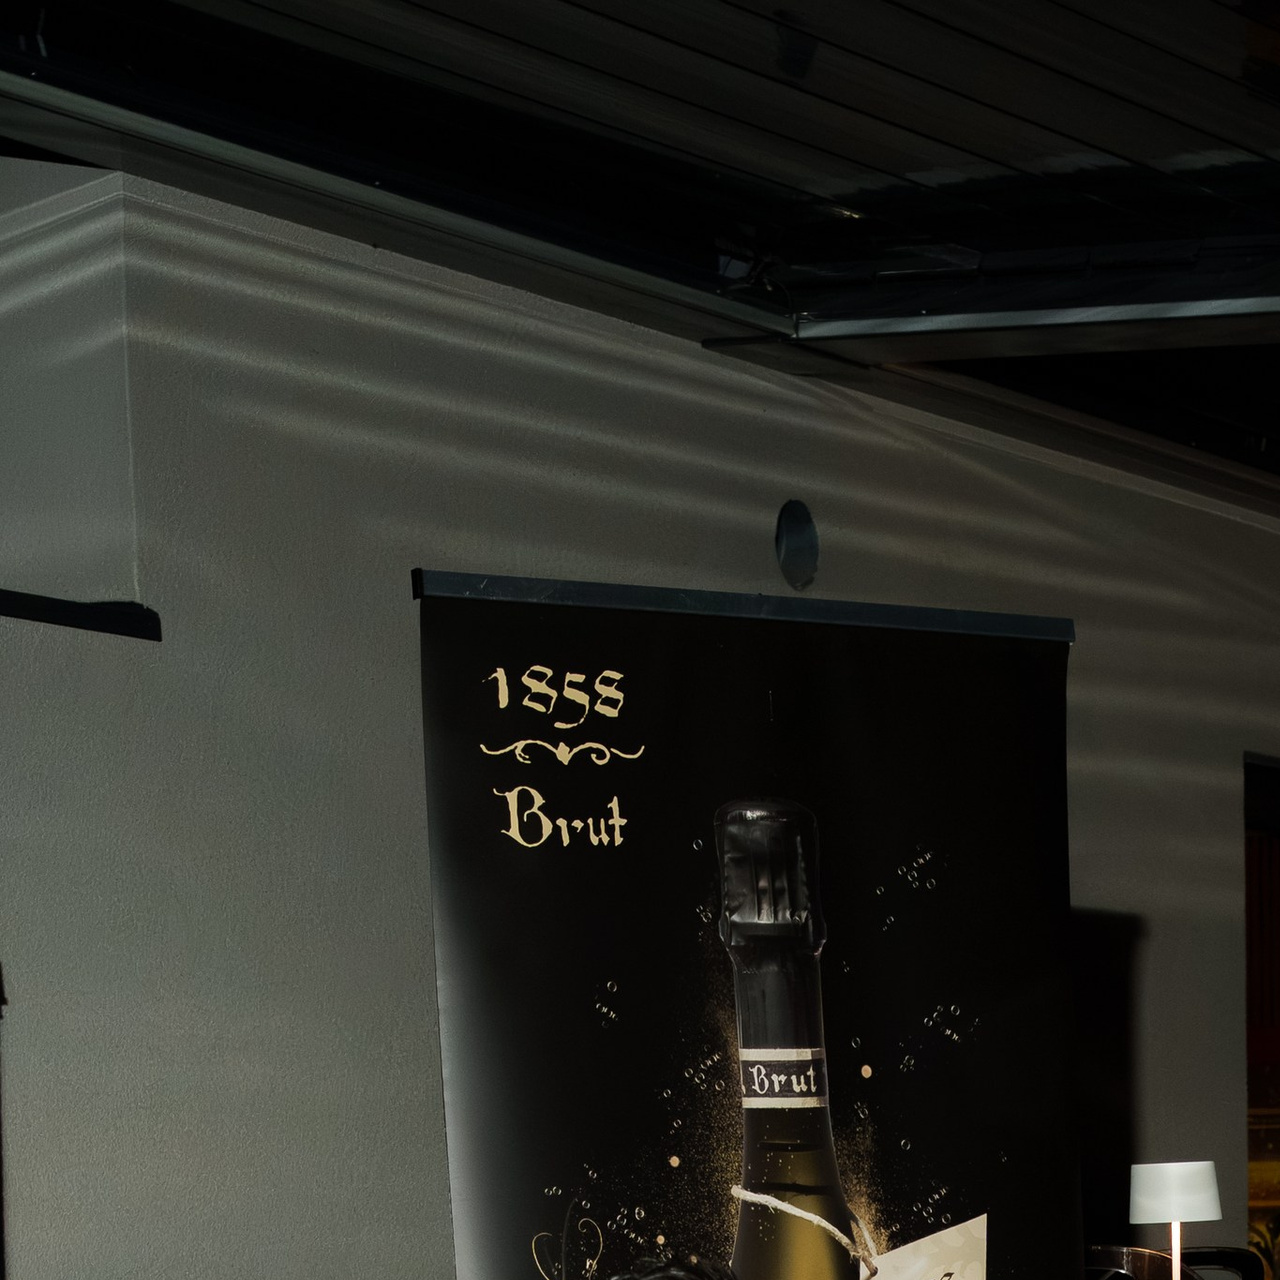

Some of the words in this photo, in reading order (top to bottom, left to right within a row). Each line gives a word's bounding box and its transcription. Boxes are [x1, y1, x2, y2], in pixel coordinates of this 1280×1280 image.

[482, 665, 624, 729] 1858
[493, 786, 628, 848] Brut
[748, 1064, 817, 1095] Brut
